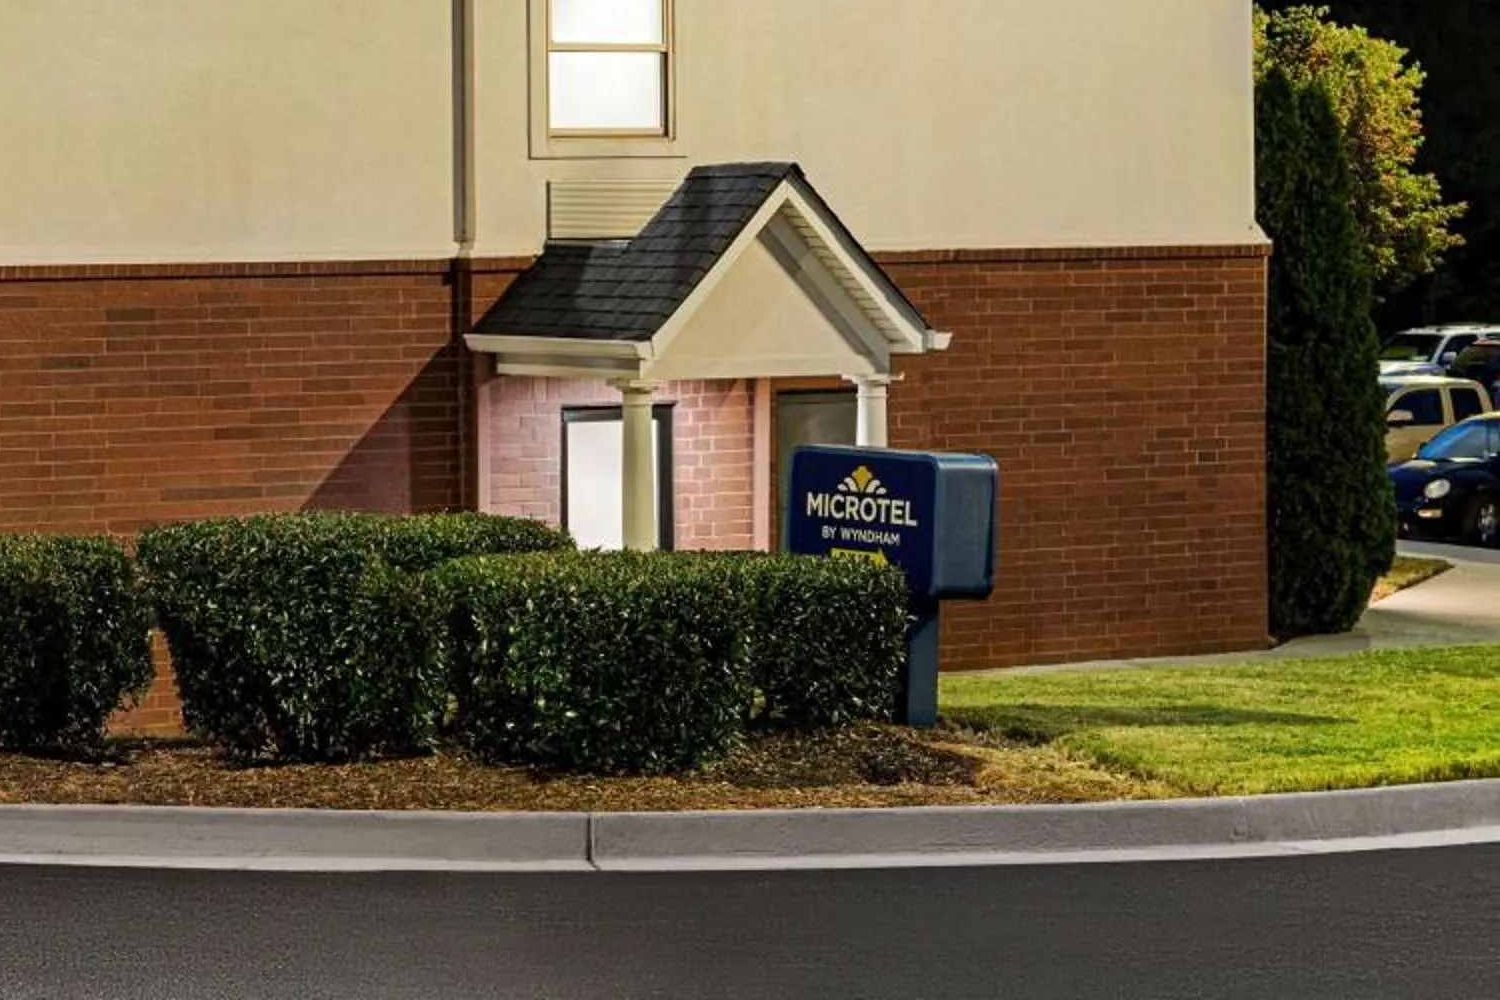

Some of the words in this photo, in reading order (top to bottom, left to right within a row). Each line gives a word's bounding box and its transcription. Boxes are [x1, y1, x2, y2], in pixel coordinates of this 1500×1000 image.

[807, 492, 918, 526] MICROTEL
[821, 525, 837, 539] BY
[841, 529, 900, 545] WYNDHAM
